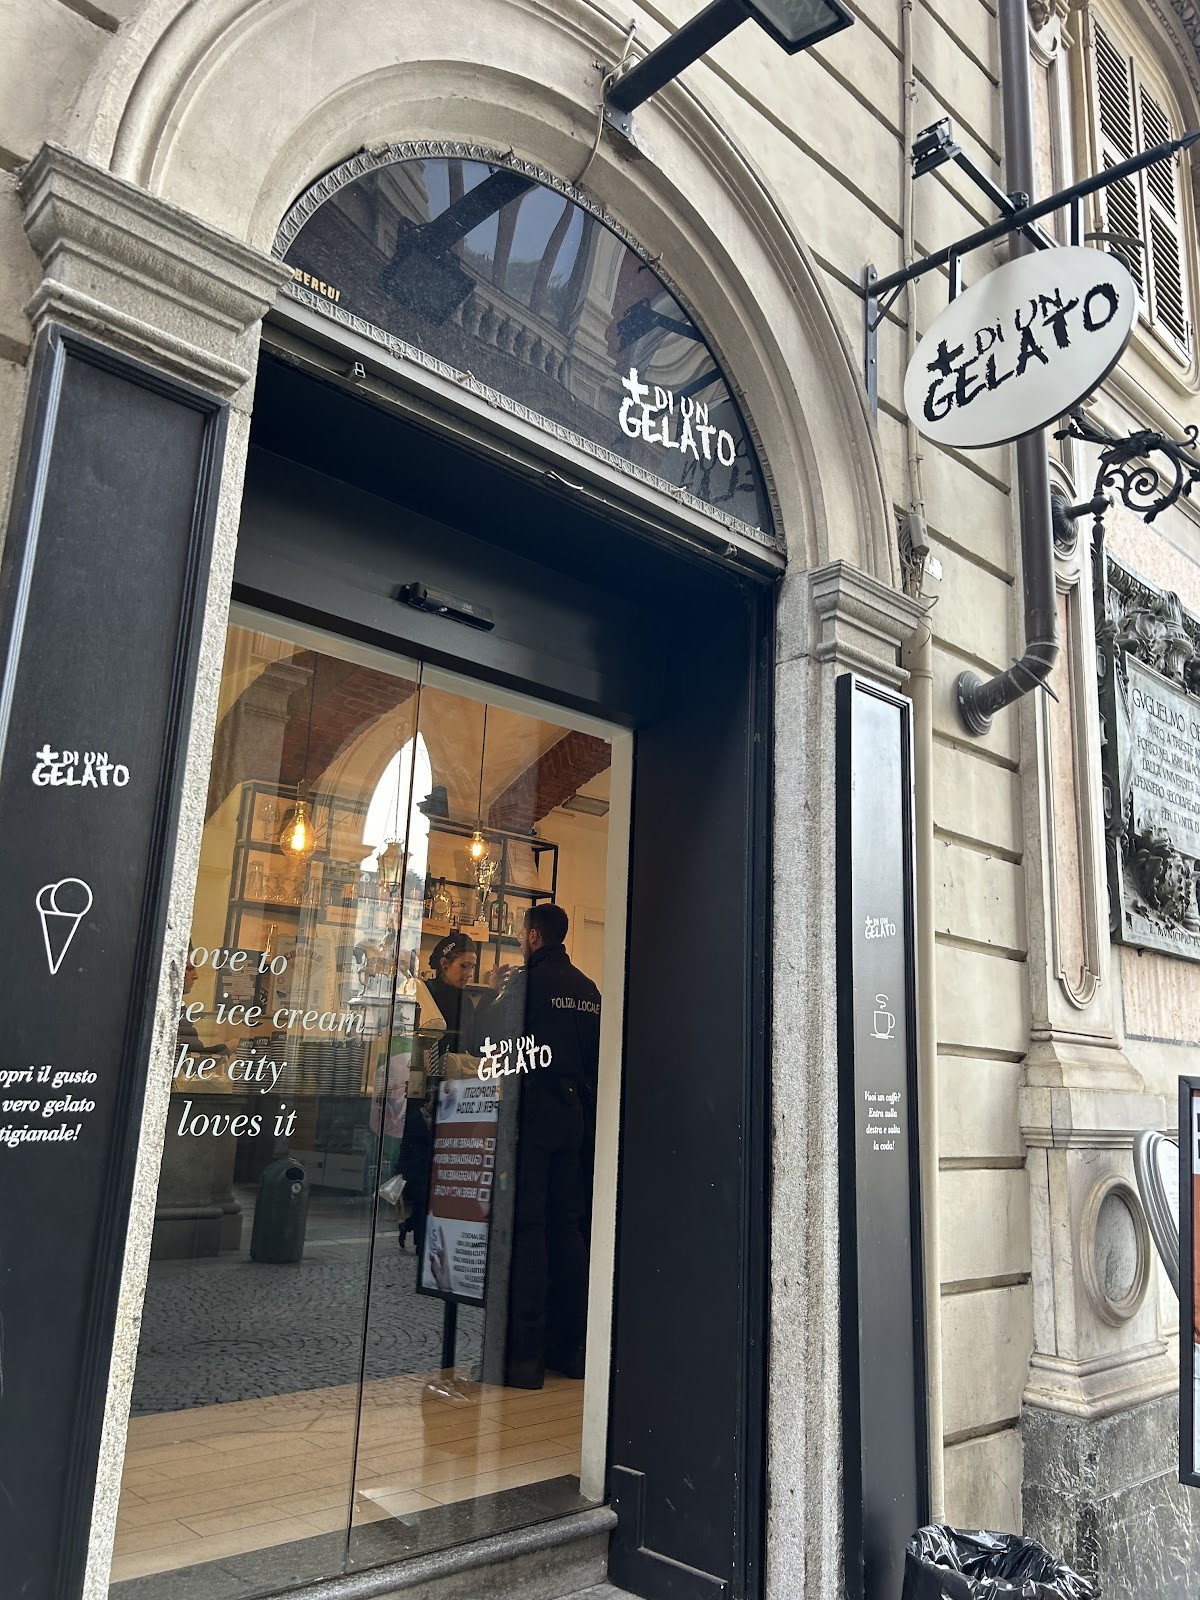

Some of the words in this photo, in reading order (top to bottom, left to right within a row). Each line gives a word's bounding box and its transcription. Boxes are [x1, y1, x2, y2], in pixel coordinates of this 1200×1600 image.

[974, 317, 1005, 355] DI
[1013, 287, 1063, 332] UN
[923, 282, 1120, 422] GELATO
[654, 385, 674, 415] DI
[680, 395, 709, 426] UN
[618, 396, 736, 467] GELATO
[62, 751, 79, 766] DI
[84, 751, 108, 766] UN
[31, 762, 130, 788] GELATO
[864, 923, 897, 940] GELATO
[188, 946, 248, 972] ove
[257, 950, 289, 976] to
[214, 992, 263, 1028] ice
[272, 1007, 365, 1034] cream
[499, 1039, 513, 1055] DI
[516, 1033, 535, 1051] UN
[173, 1043, 217, 1079] he
[226, 1048, 289, 1095] city
[477, 1044, 553, 1081] GELATO
[0, 1065, 35, 1088] opri
[36, 1065, 52, 1083] il
[51, 1069, 98, 1089] gusto
[2, 1099, 41, 1112] vero
[41, 1094, 96, 1118] gelato
[877, 1094, 885, 1102] un
[176, 1100, 264, 1137] loves
[272, 1103, 299, 1137] it
[868, 1107, 884, 1118] Entra
[0, 1123, 83, 1148] tigianale!
[865, 1123, 882, 1134] destra
[883, 1126, 887, 1134] e
[873, 1139, 879, 1151] la
